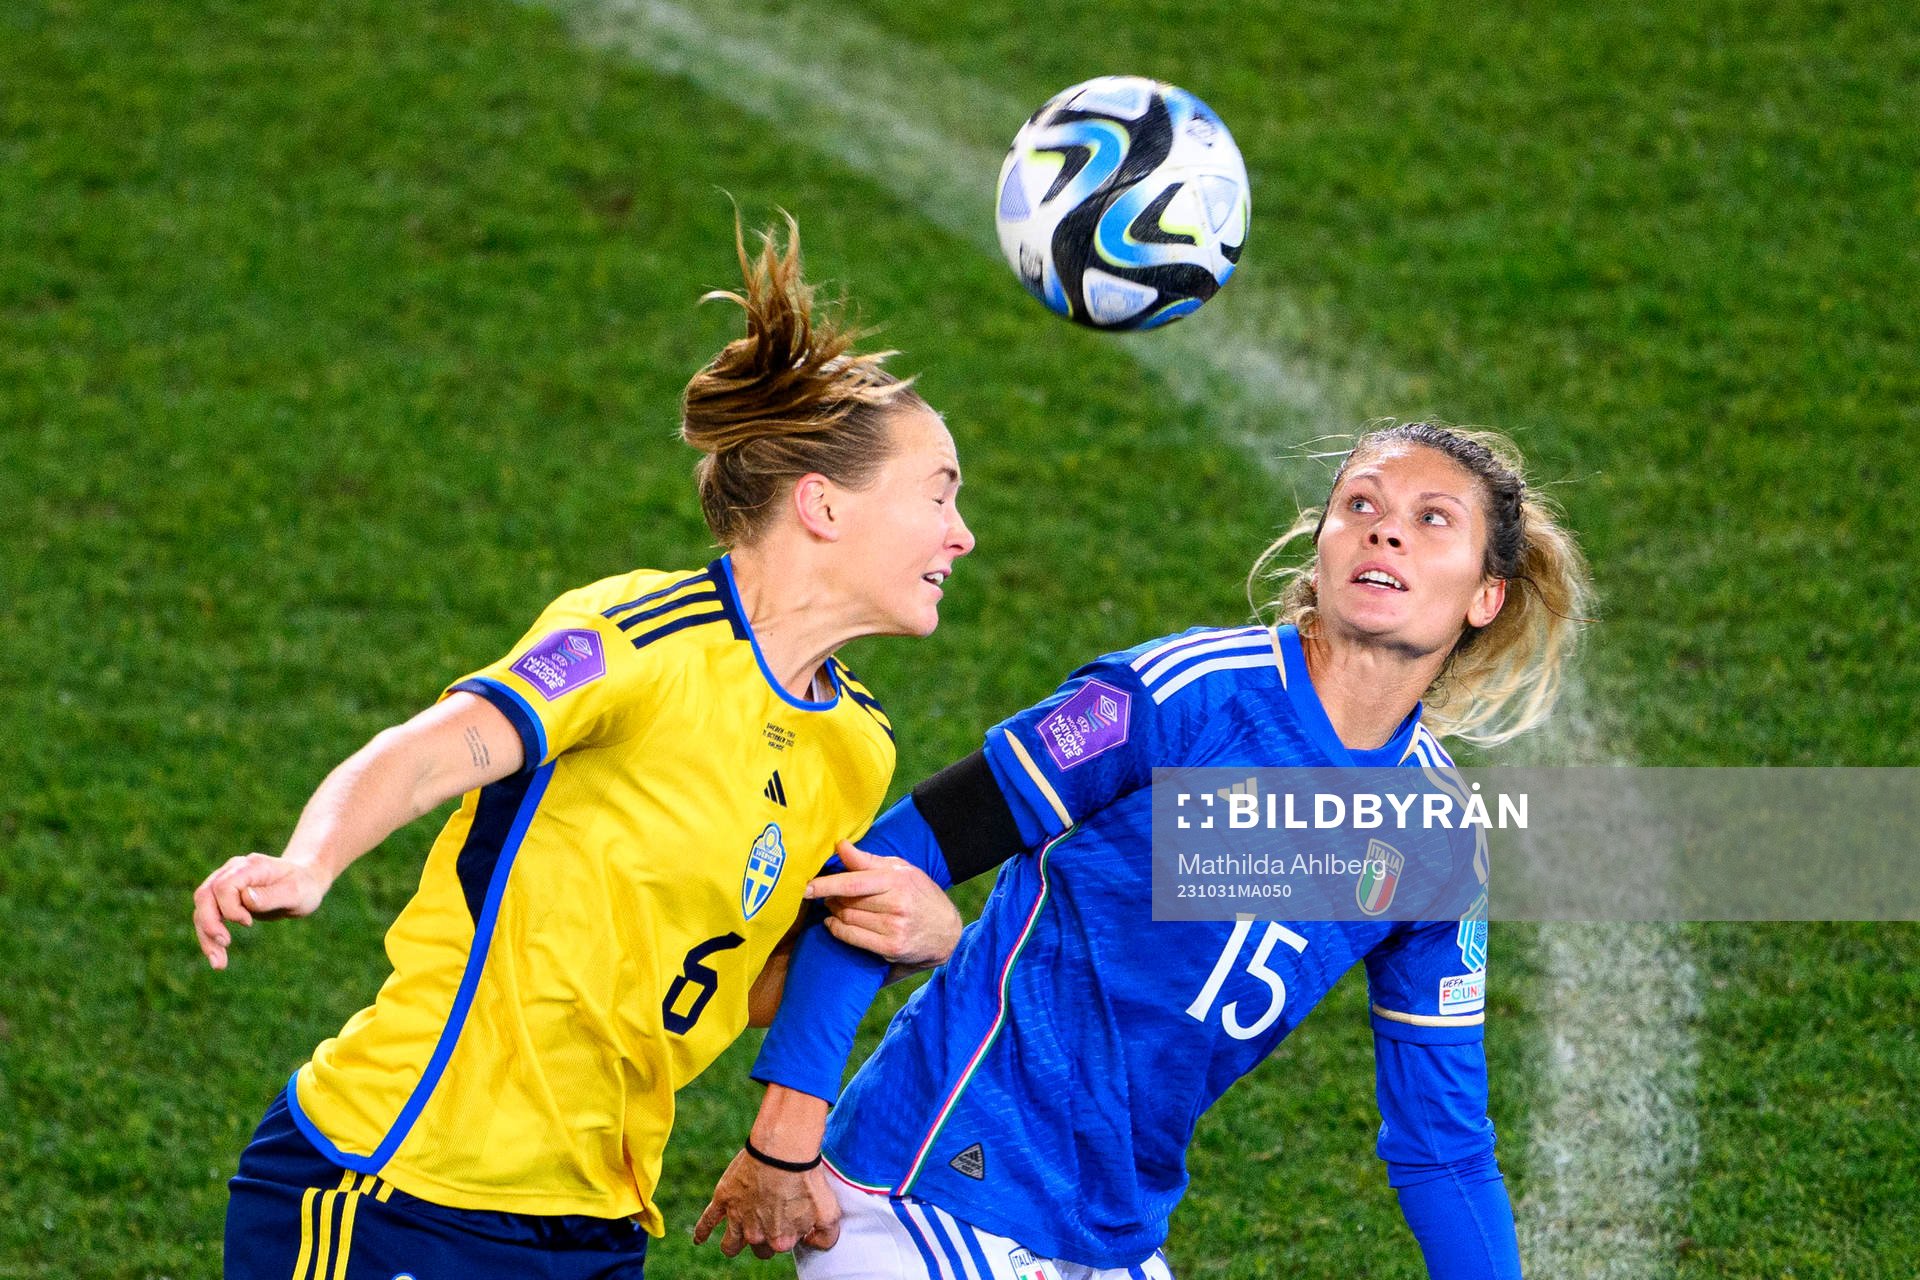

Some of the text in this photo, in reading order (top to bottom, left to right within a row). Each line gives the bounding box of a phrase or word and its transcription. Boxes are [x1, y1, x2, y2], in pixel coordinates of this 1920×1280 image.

[522, 662, 558, 691] LEAGUE
[527, 656, 566, 688] NATIONS
[1049, 721, 1075, 760] LEAGUE
[1055, 714, 1084, 757] NATIONS
[1370, 844, 1400, 873] ITALIA
[662, 931, 746, 1035] 6
[1185, 912, 1309, 1040] 15
[1443, 978, 1464, 988] UEFA
[1443, 985, 1483, 1002] FOUN
